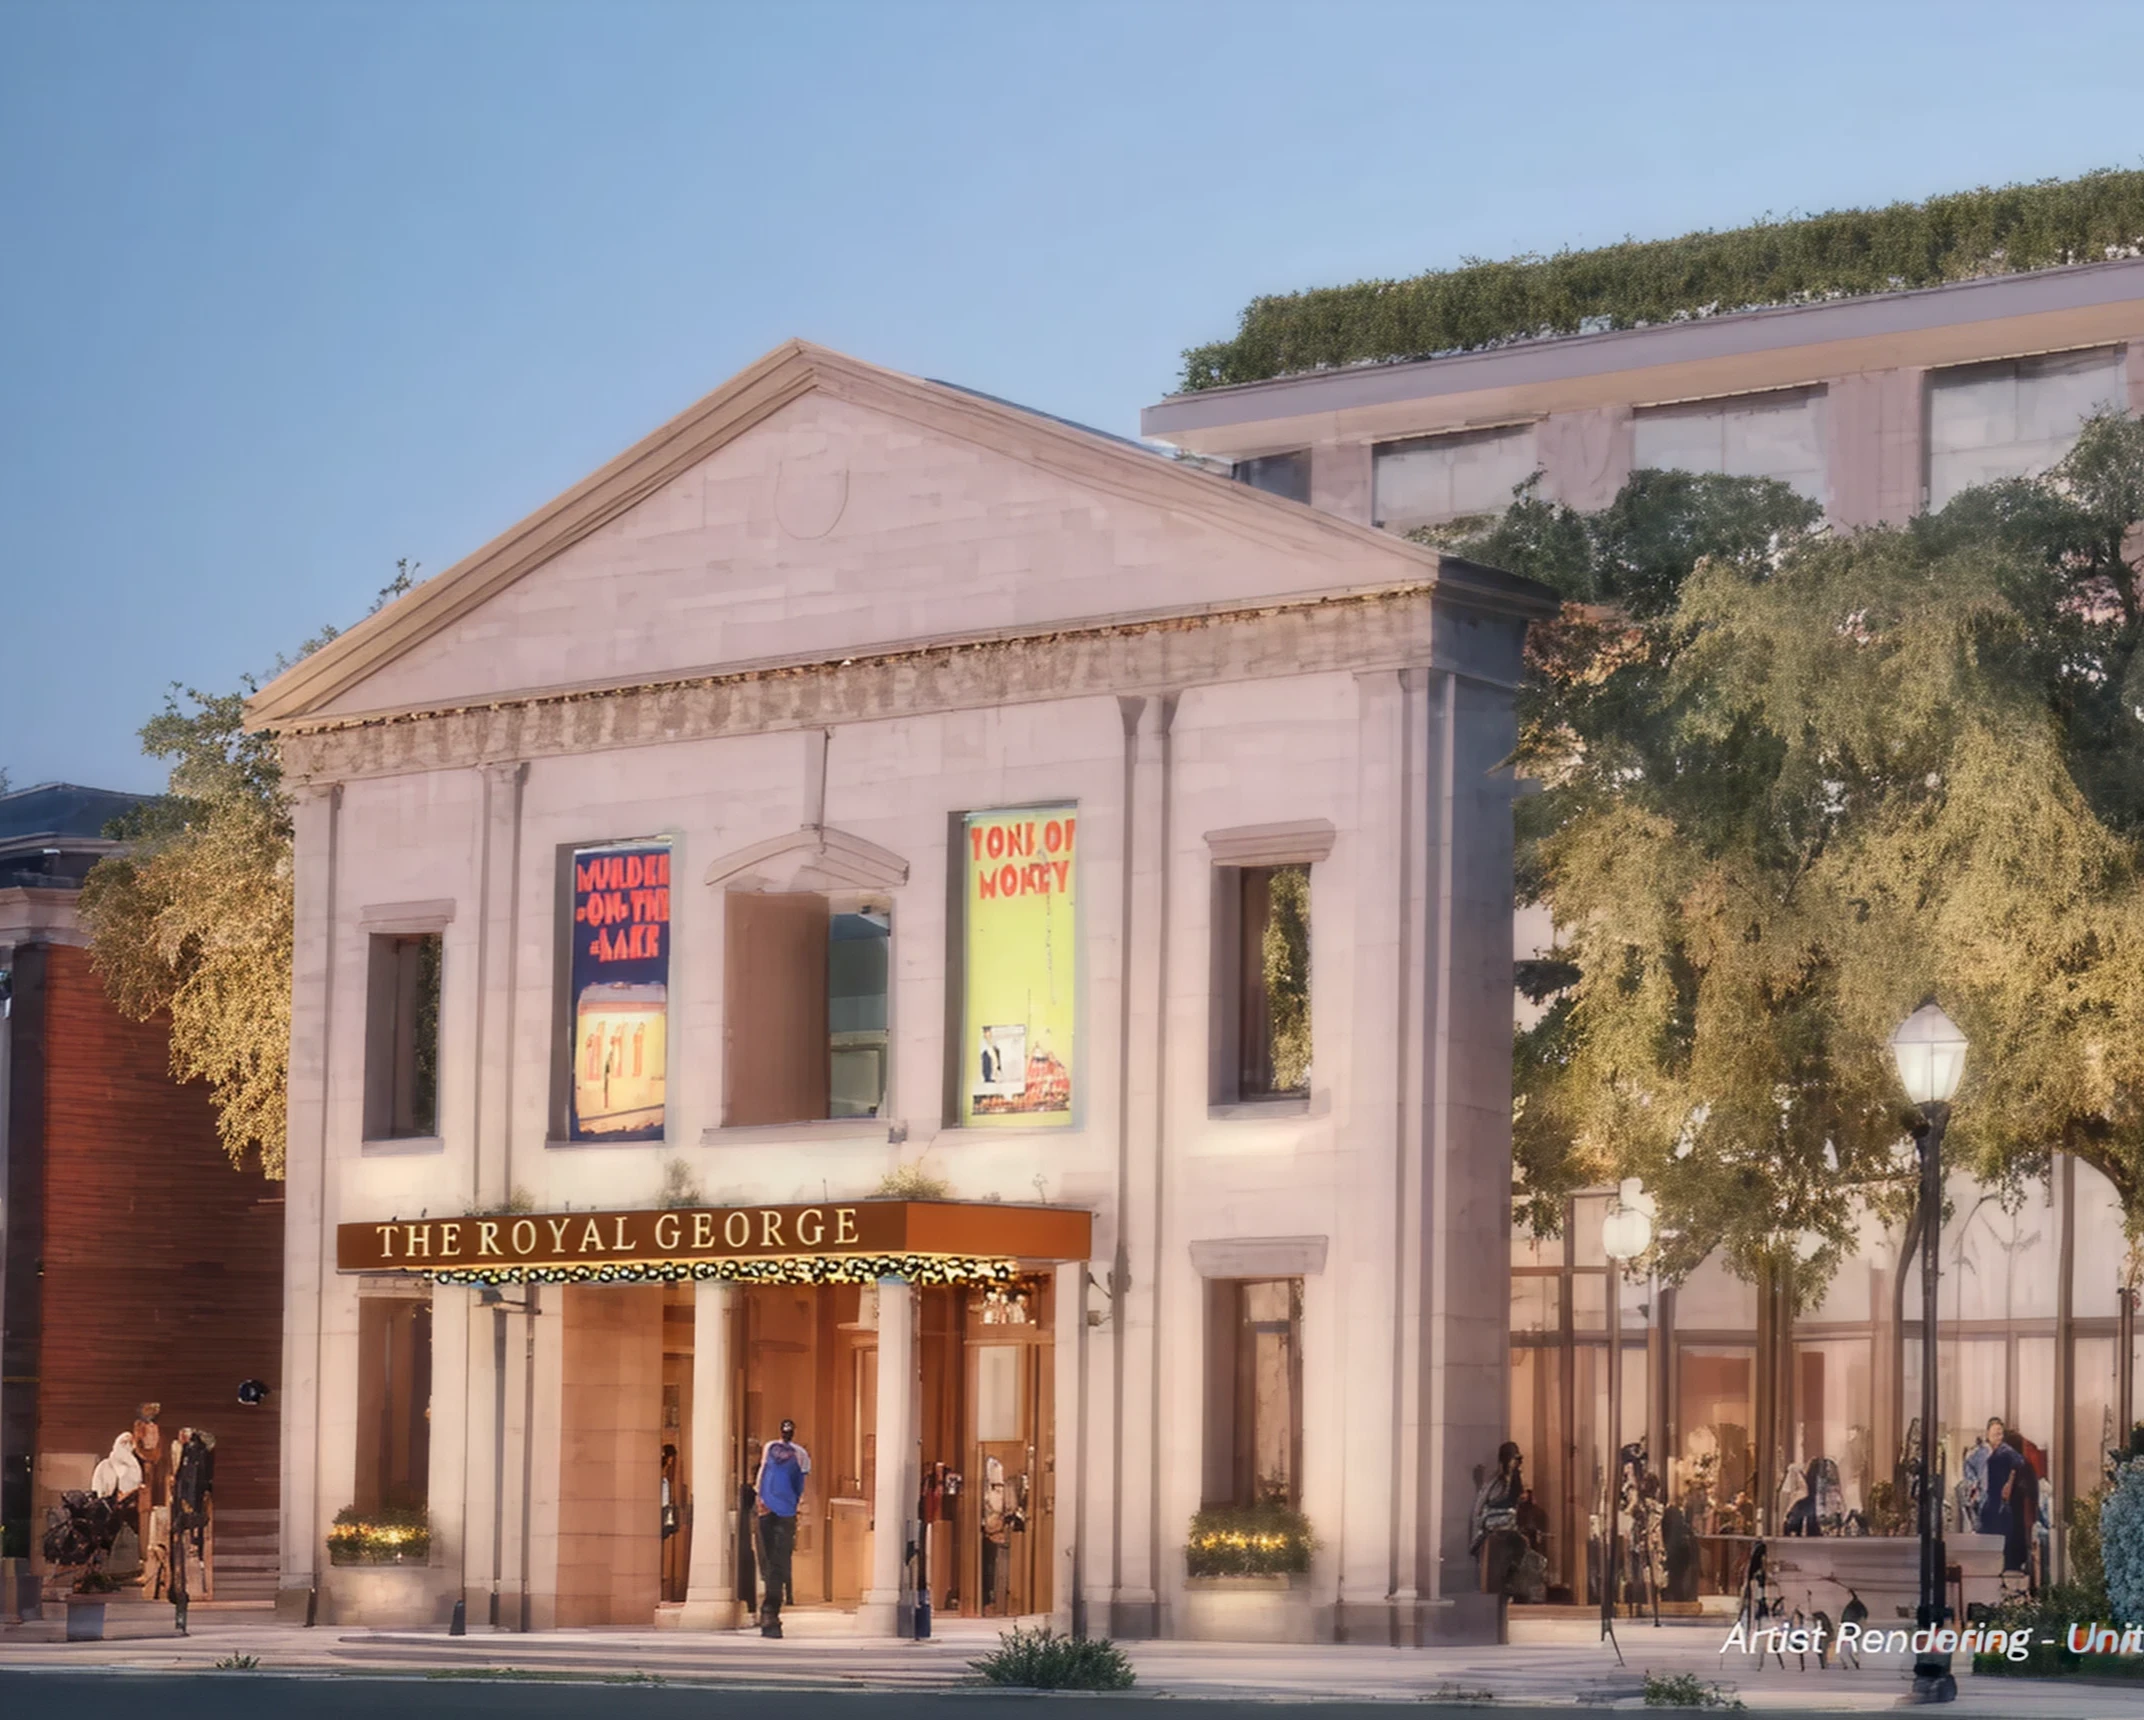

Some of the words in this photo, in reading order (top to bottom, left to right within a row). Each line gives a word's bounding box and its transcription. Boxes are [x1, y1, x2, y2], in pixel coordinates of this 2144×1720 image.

[376, 1222, 461, 1258] THE
[477, 1216, 637, 1256] ROYAL
[655, 1208, 860, 1250] GEORGE
